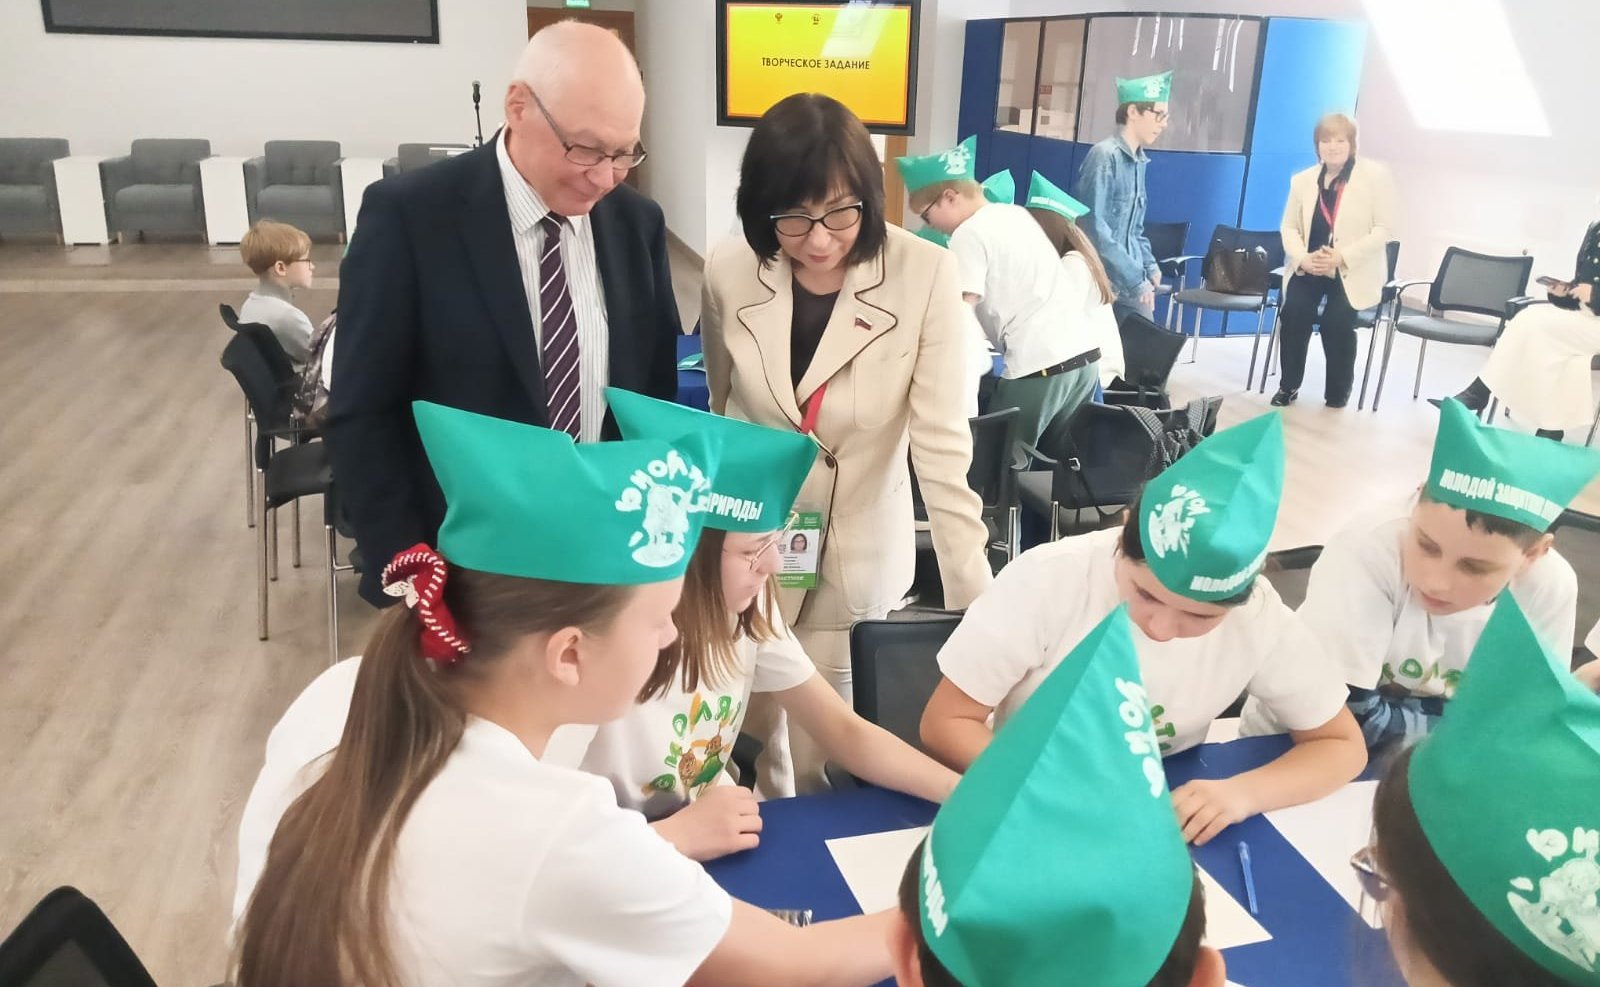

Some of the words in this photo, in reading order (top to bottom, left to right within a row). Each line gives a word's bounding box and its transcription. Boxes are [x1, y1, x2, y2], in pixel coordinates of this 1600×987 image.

[761, 57, 822, 69] ТВОРЧЕСКОЕ
[824, 59, 870, 70] ЗАДАНИЕ
[708, 492, 764, 523] РИРОДЫ
